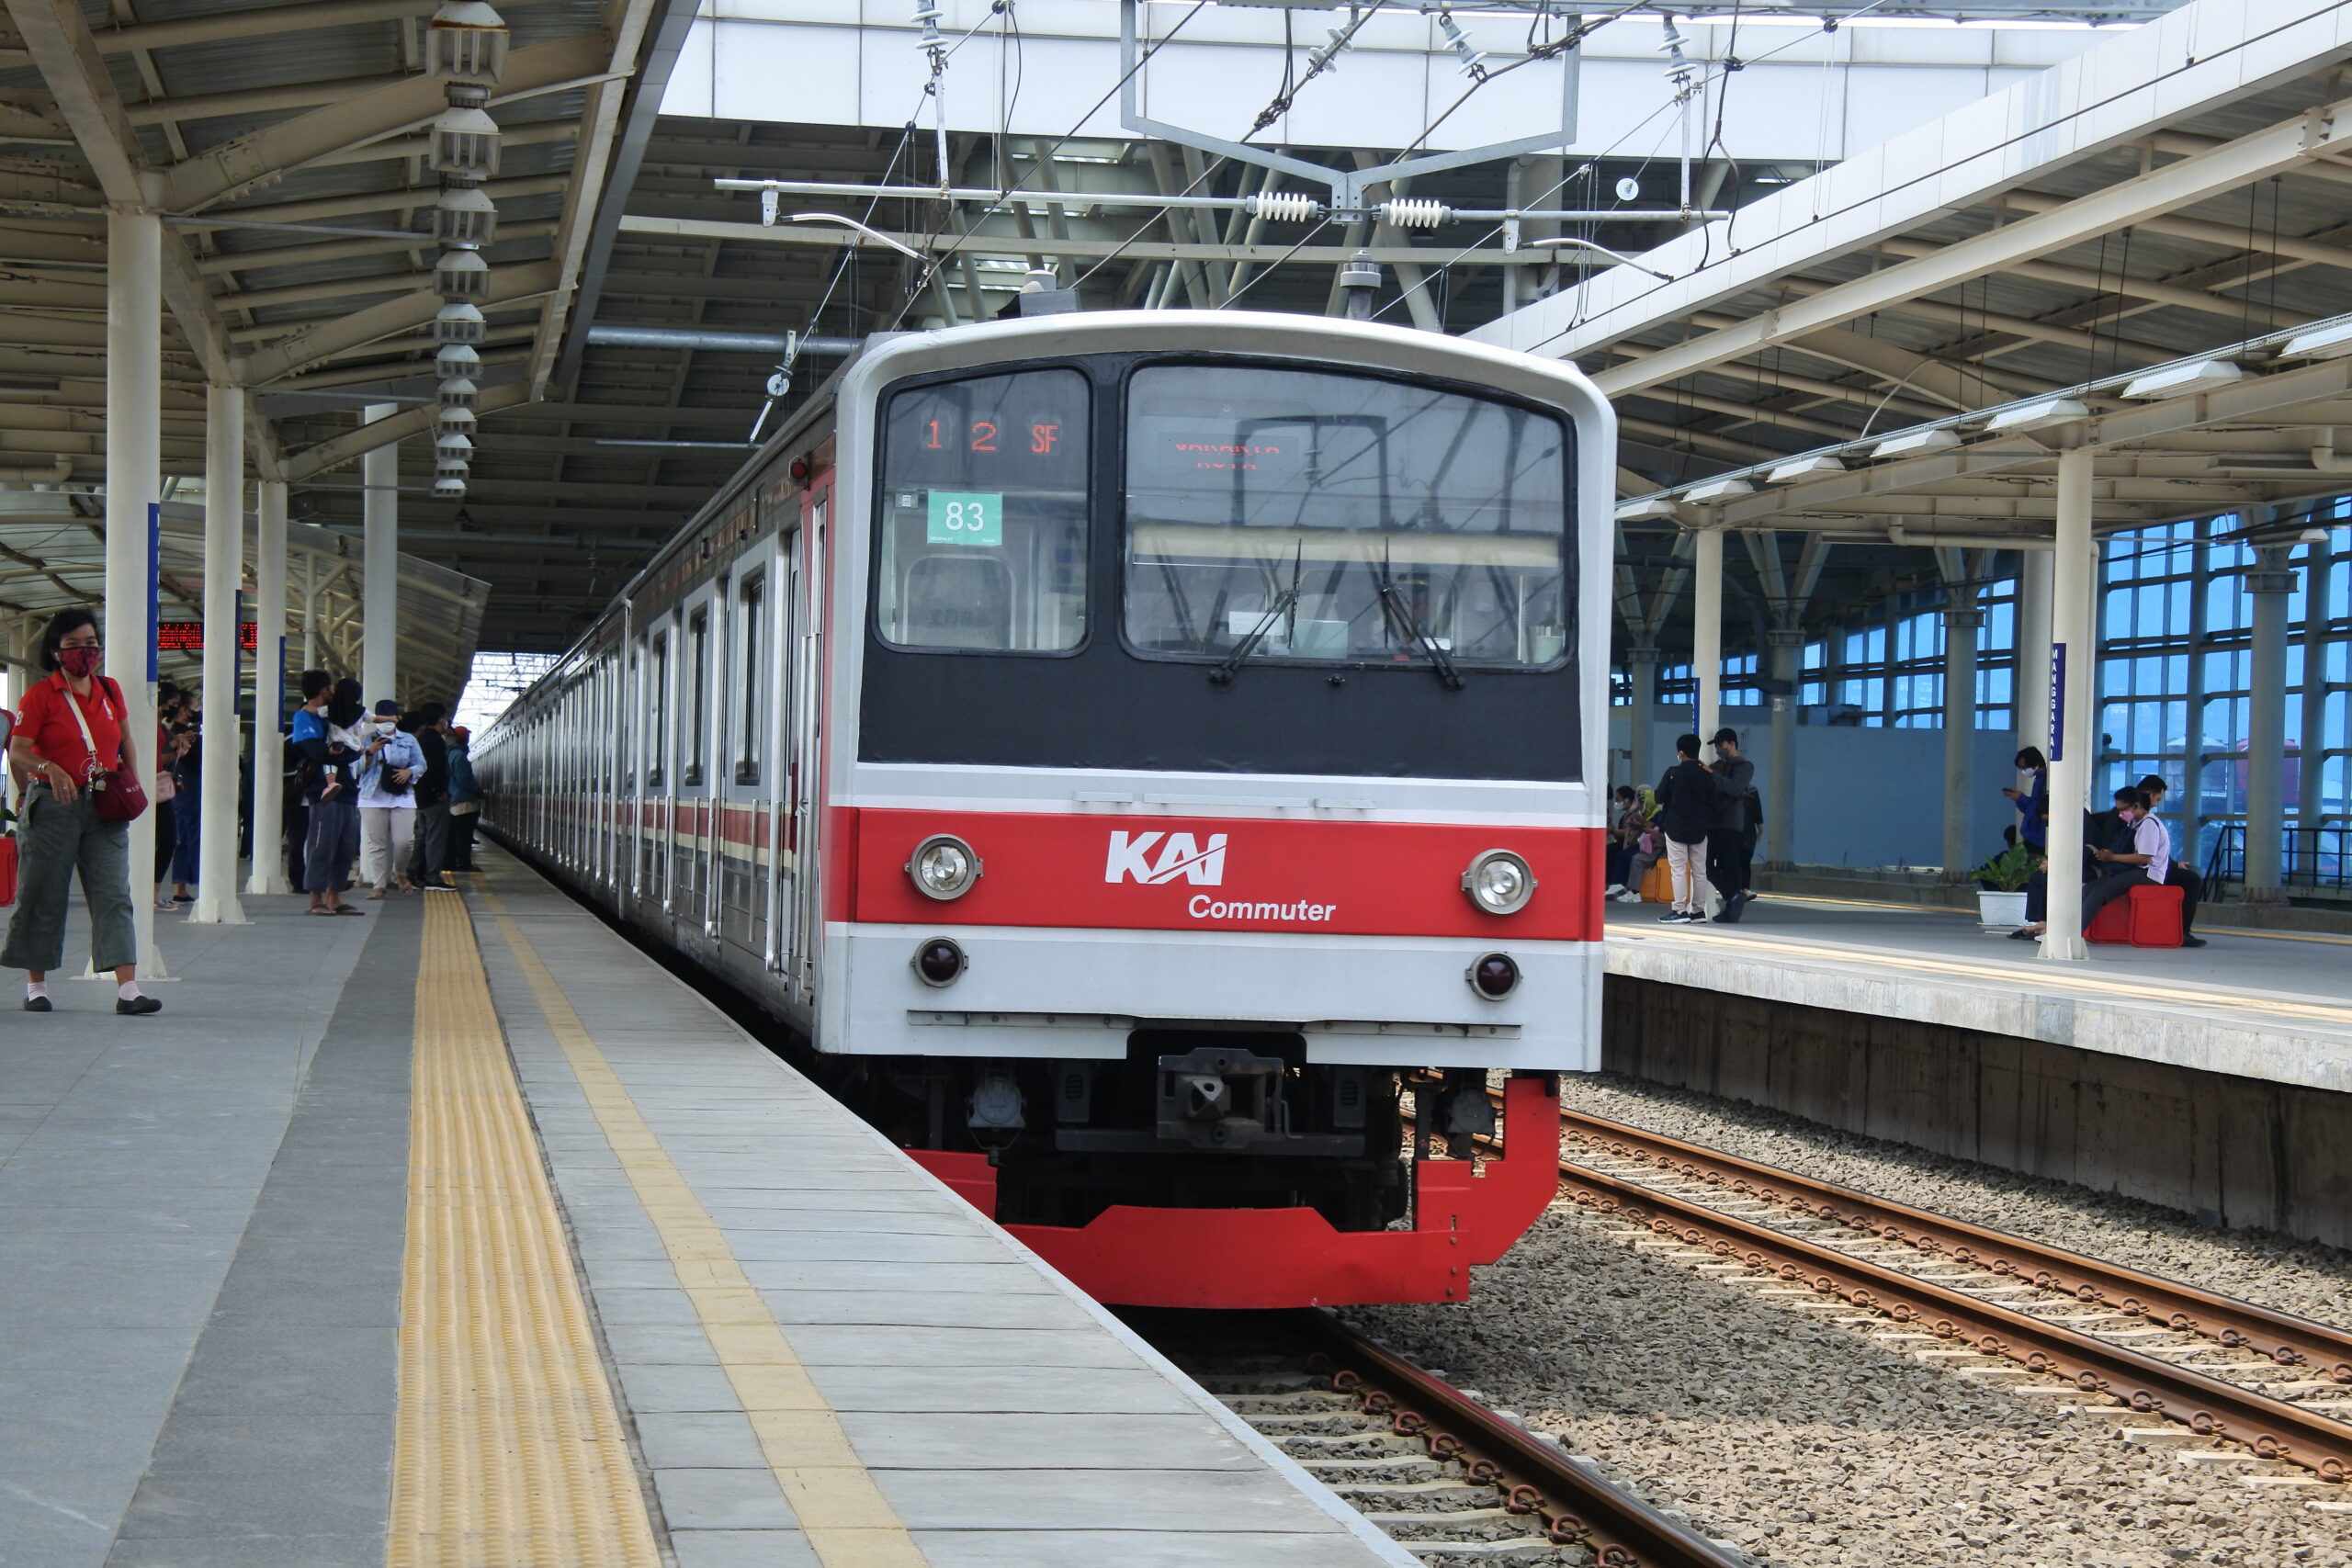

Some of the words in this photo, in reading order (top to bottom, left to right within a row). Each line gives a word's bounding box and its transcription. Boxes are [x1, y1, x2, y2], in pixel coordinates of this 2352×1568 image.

[926, 420, 943, 449] 1
[970, 422, 998, 451] 2
[1031, 423, 1059, 453] SF
[945, 501, 985, 532] 83
[2050, 649, 2059, 760] MANGGARAI
[1104, 830, 1228, 886] KAI
[1188, 894, 1337, 921] Commuter
